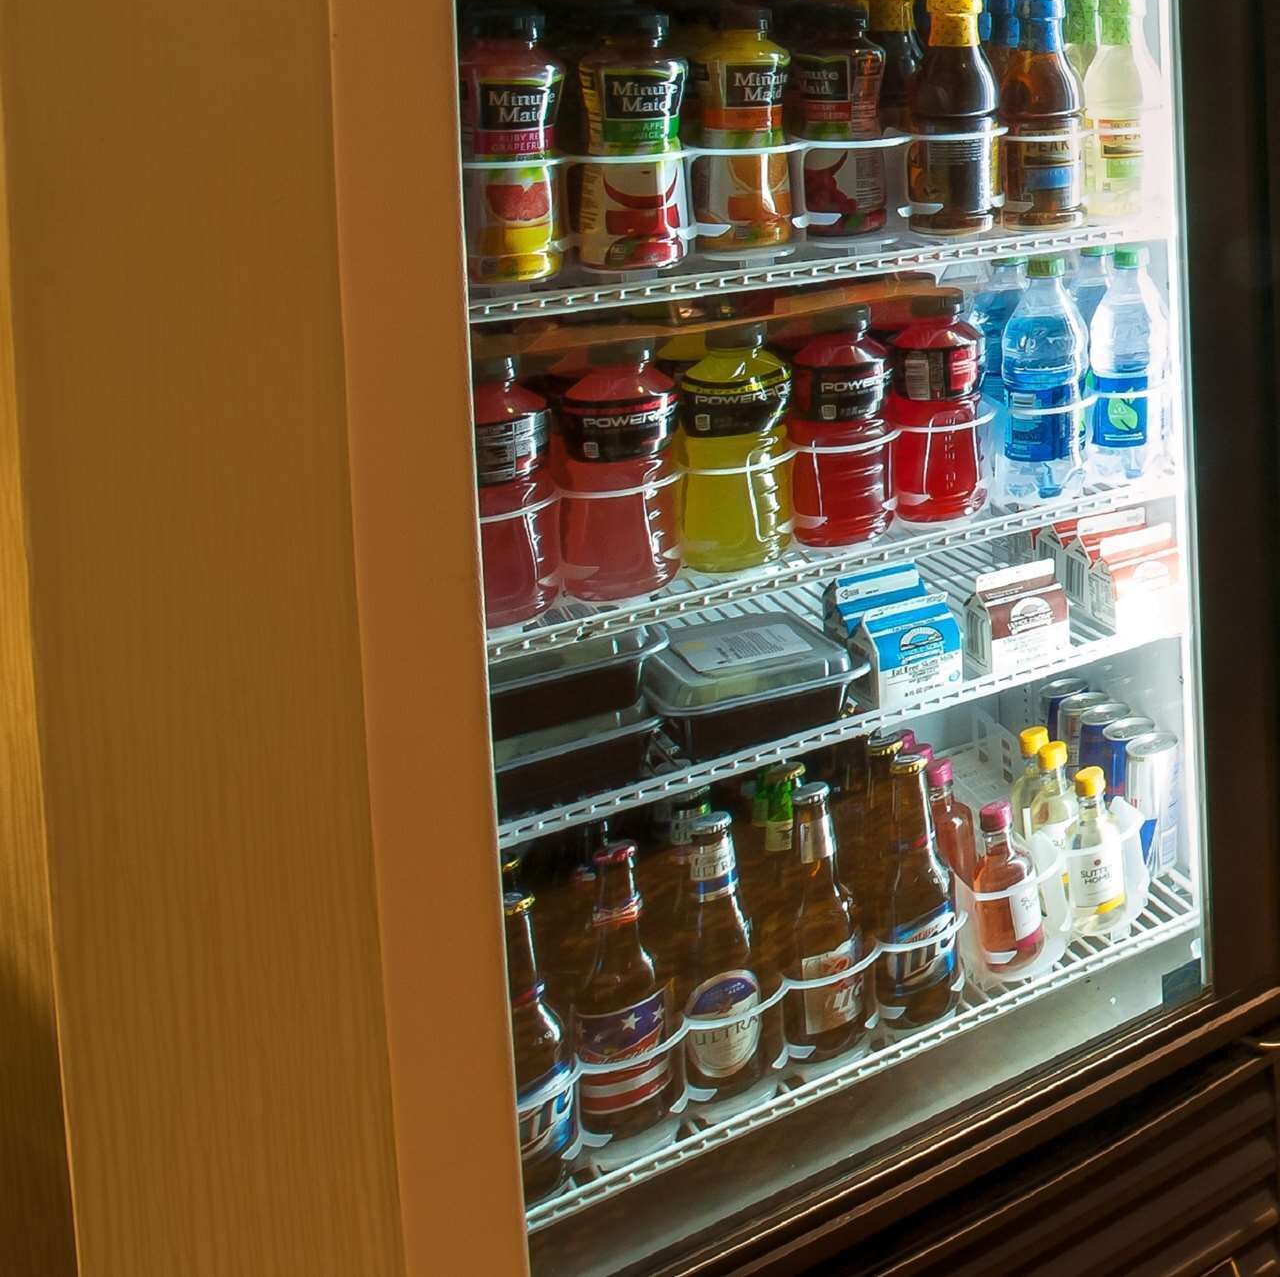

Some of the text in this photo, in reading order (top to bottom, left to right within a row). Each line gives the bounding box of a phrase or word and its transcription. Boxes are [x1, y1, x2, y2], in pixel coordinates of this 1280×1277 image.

[820, 368, 895, 393] POWER
[583, 404, 677, 429] POWER
[1080, 864, 1113, 878] SUTT
[693, 1013, 759, 1046] ULTRA
